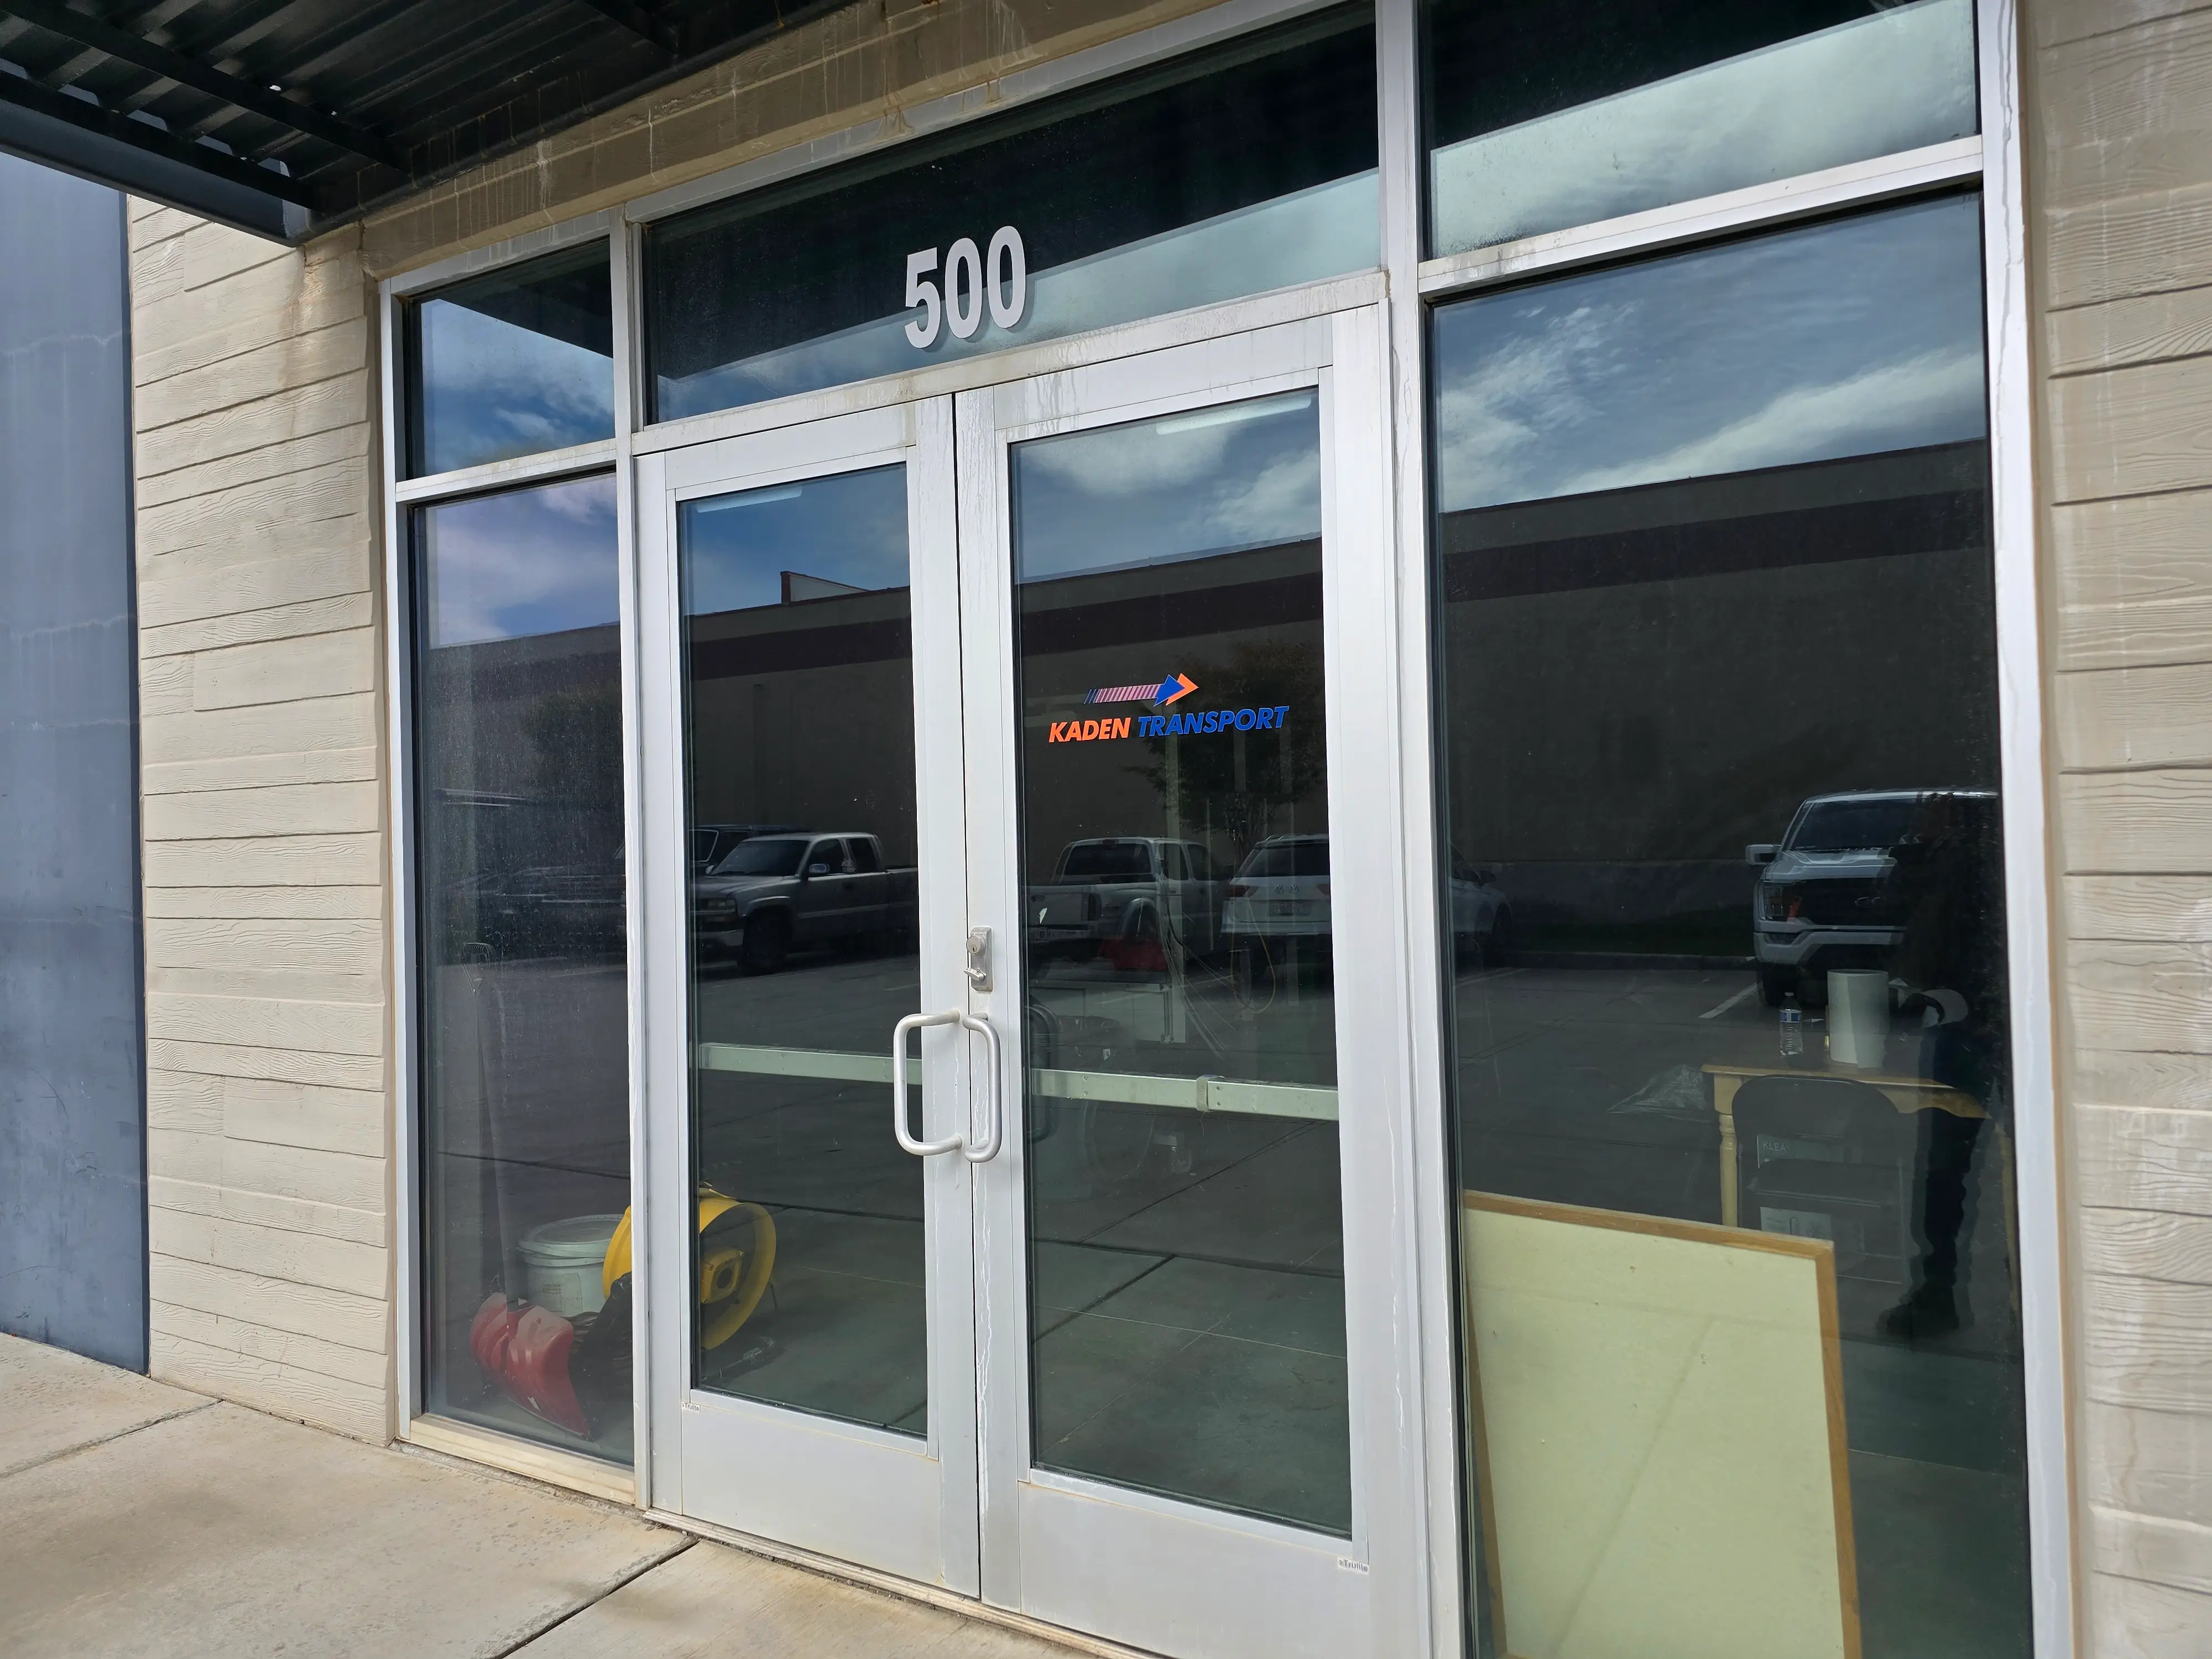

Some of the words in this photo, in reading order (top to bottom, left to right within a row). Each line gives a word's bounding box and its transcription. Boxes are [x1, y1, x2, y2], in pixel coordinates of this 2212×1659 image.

[905, 226, 1026, 348] 500
[1048, 717, 1131, 743] KADEN
[1137, 705, 1290, 738] TRANSPORT
